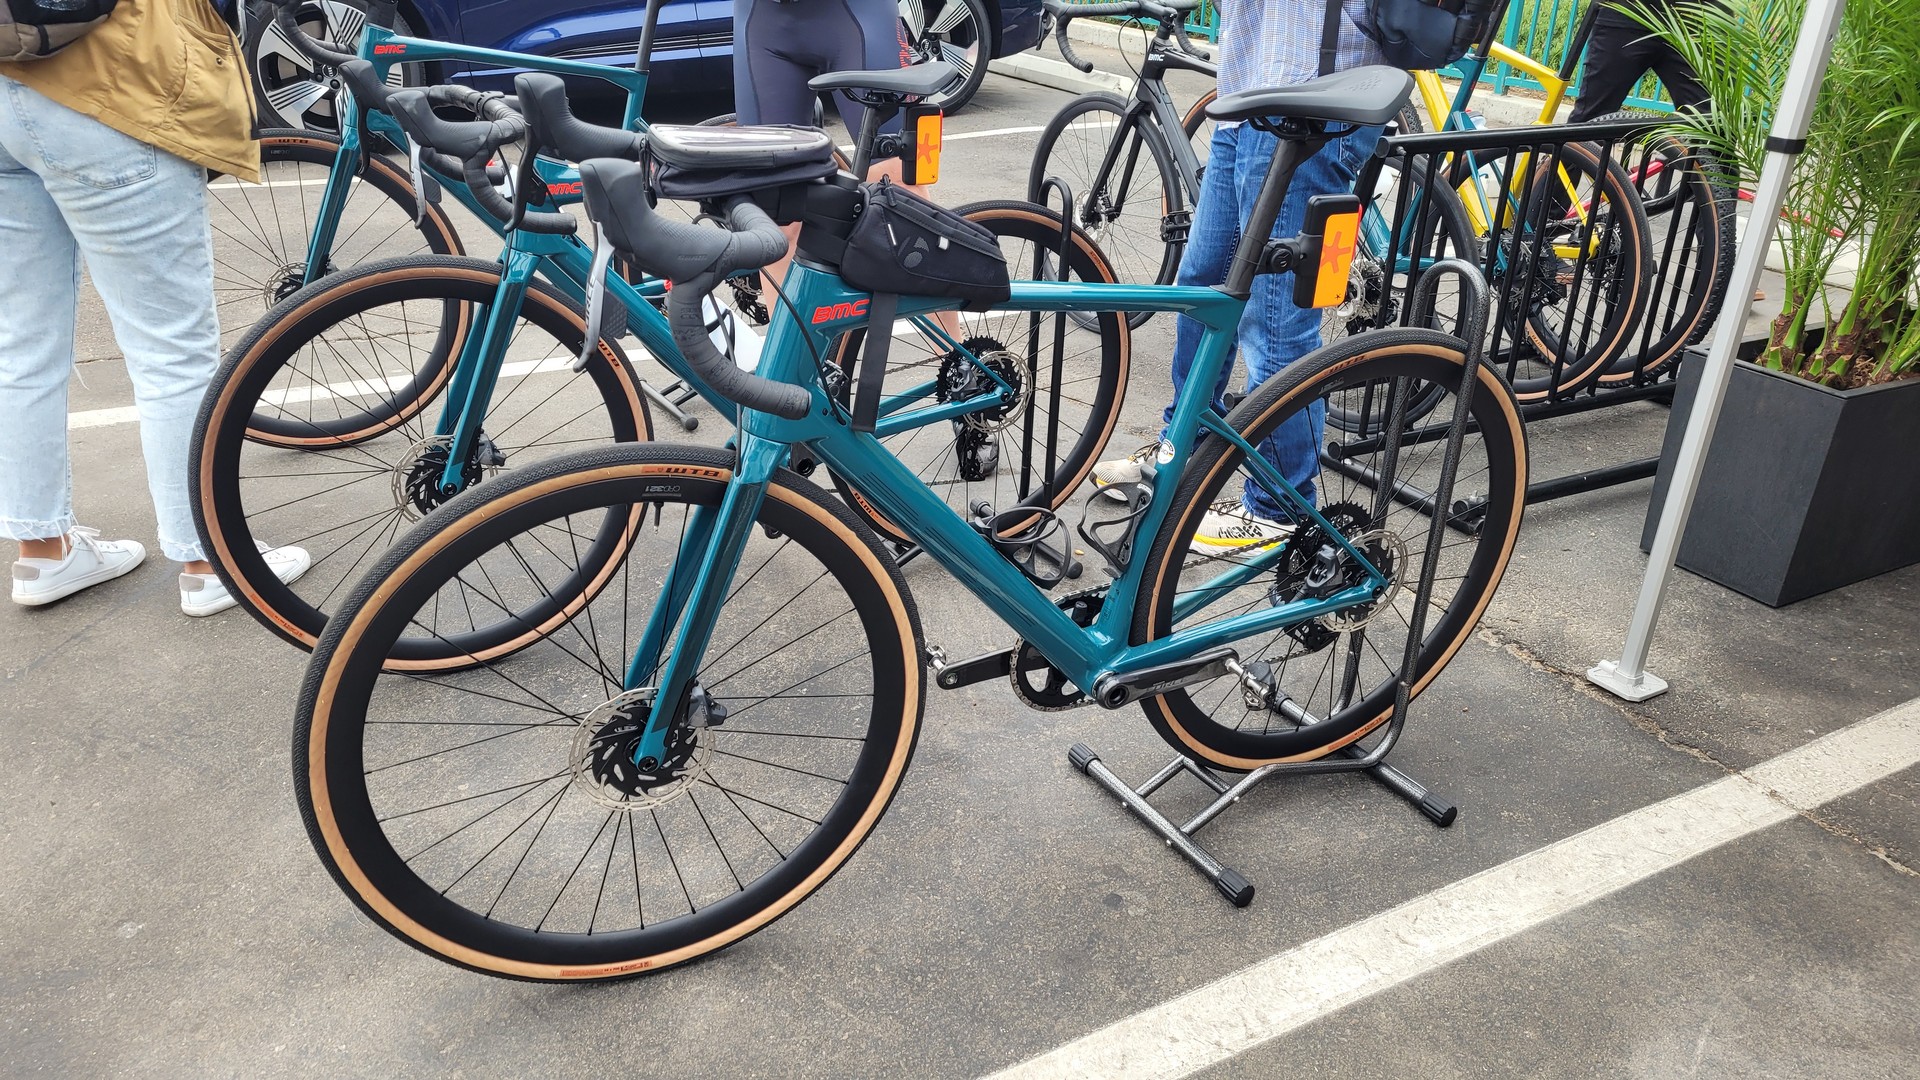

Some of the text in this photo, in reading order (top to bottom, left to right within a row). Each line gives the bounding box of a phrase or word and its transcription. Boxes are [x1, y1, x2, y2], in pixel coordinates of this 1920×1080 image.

[374, 44, 407, 54] BMC
[1148, 53, 1165, 61] BMC
[546, 181, 583, 196] BMC
[811, 298, 870, 325] BMC
[665, 467, 720, 477] WTB
